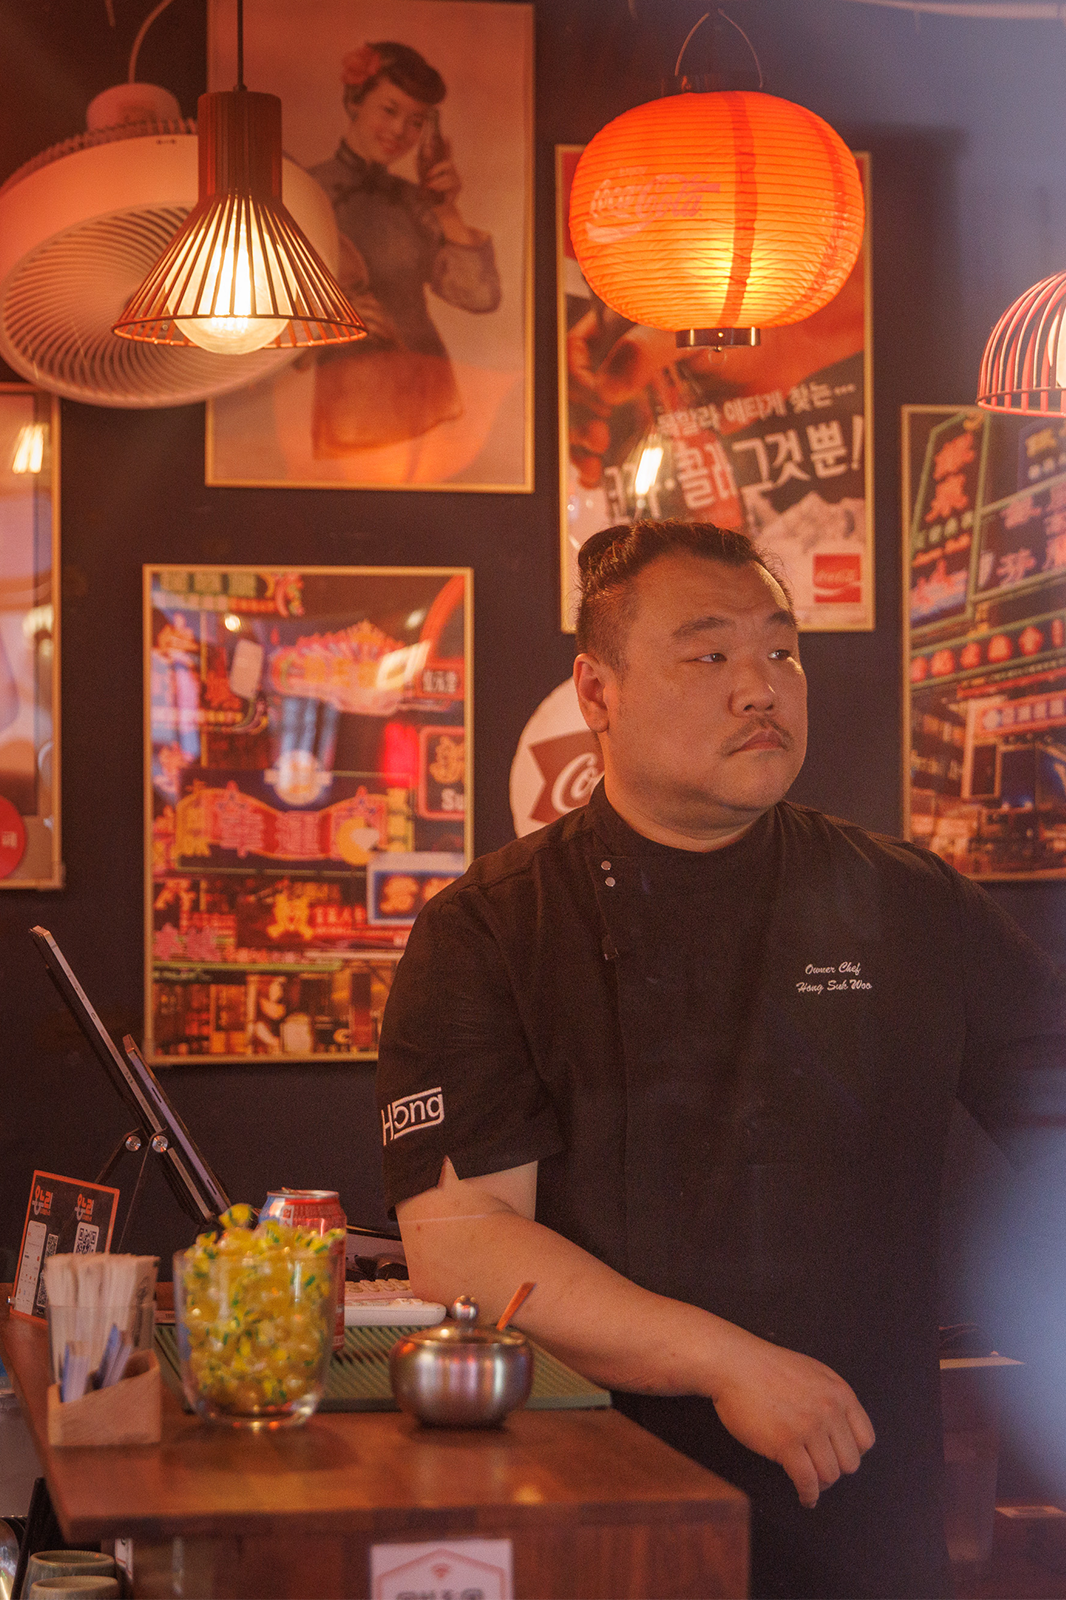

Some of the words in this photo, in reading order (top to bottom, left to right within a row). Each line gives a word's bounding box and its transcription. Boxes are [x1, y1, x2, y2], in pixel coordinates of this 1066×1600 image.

[657, 404, 721, 437] 목말라
[732, 429, 811, 492] 그것
[806, 415, 864, 479] 뿐!
[804, 963, 836, 975] Owner
[838, 961, 861, 976] Chef
[795, 981, 824, 995] Hong
[826, 979, 849, 991] Suk
[849, 978, 873, 990] Woo
[380, 1086, 445, 1147] Hong
